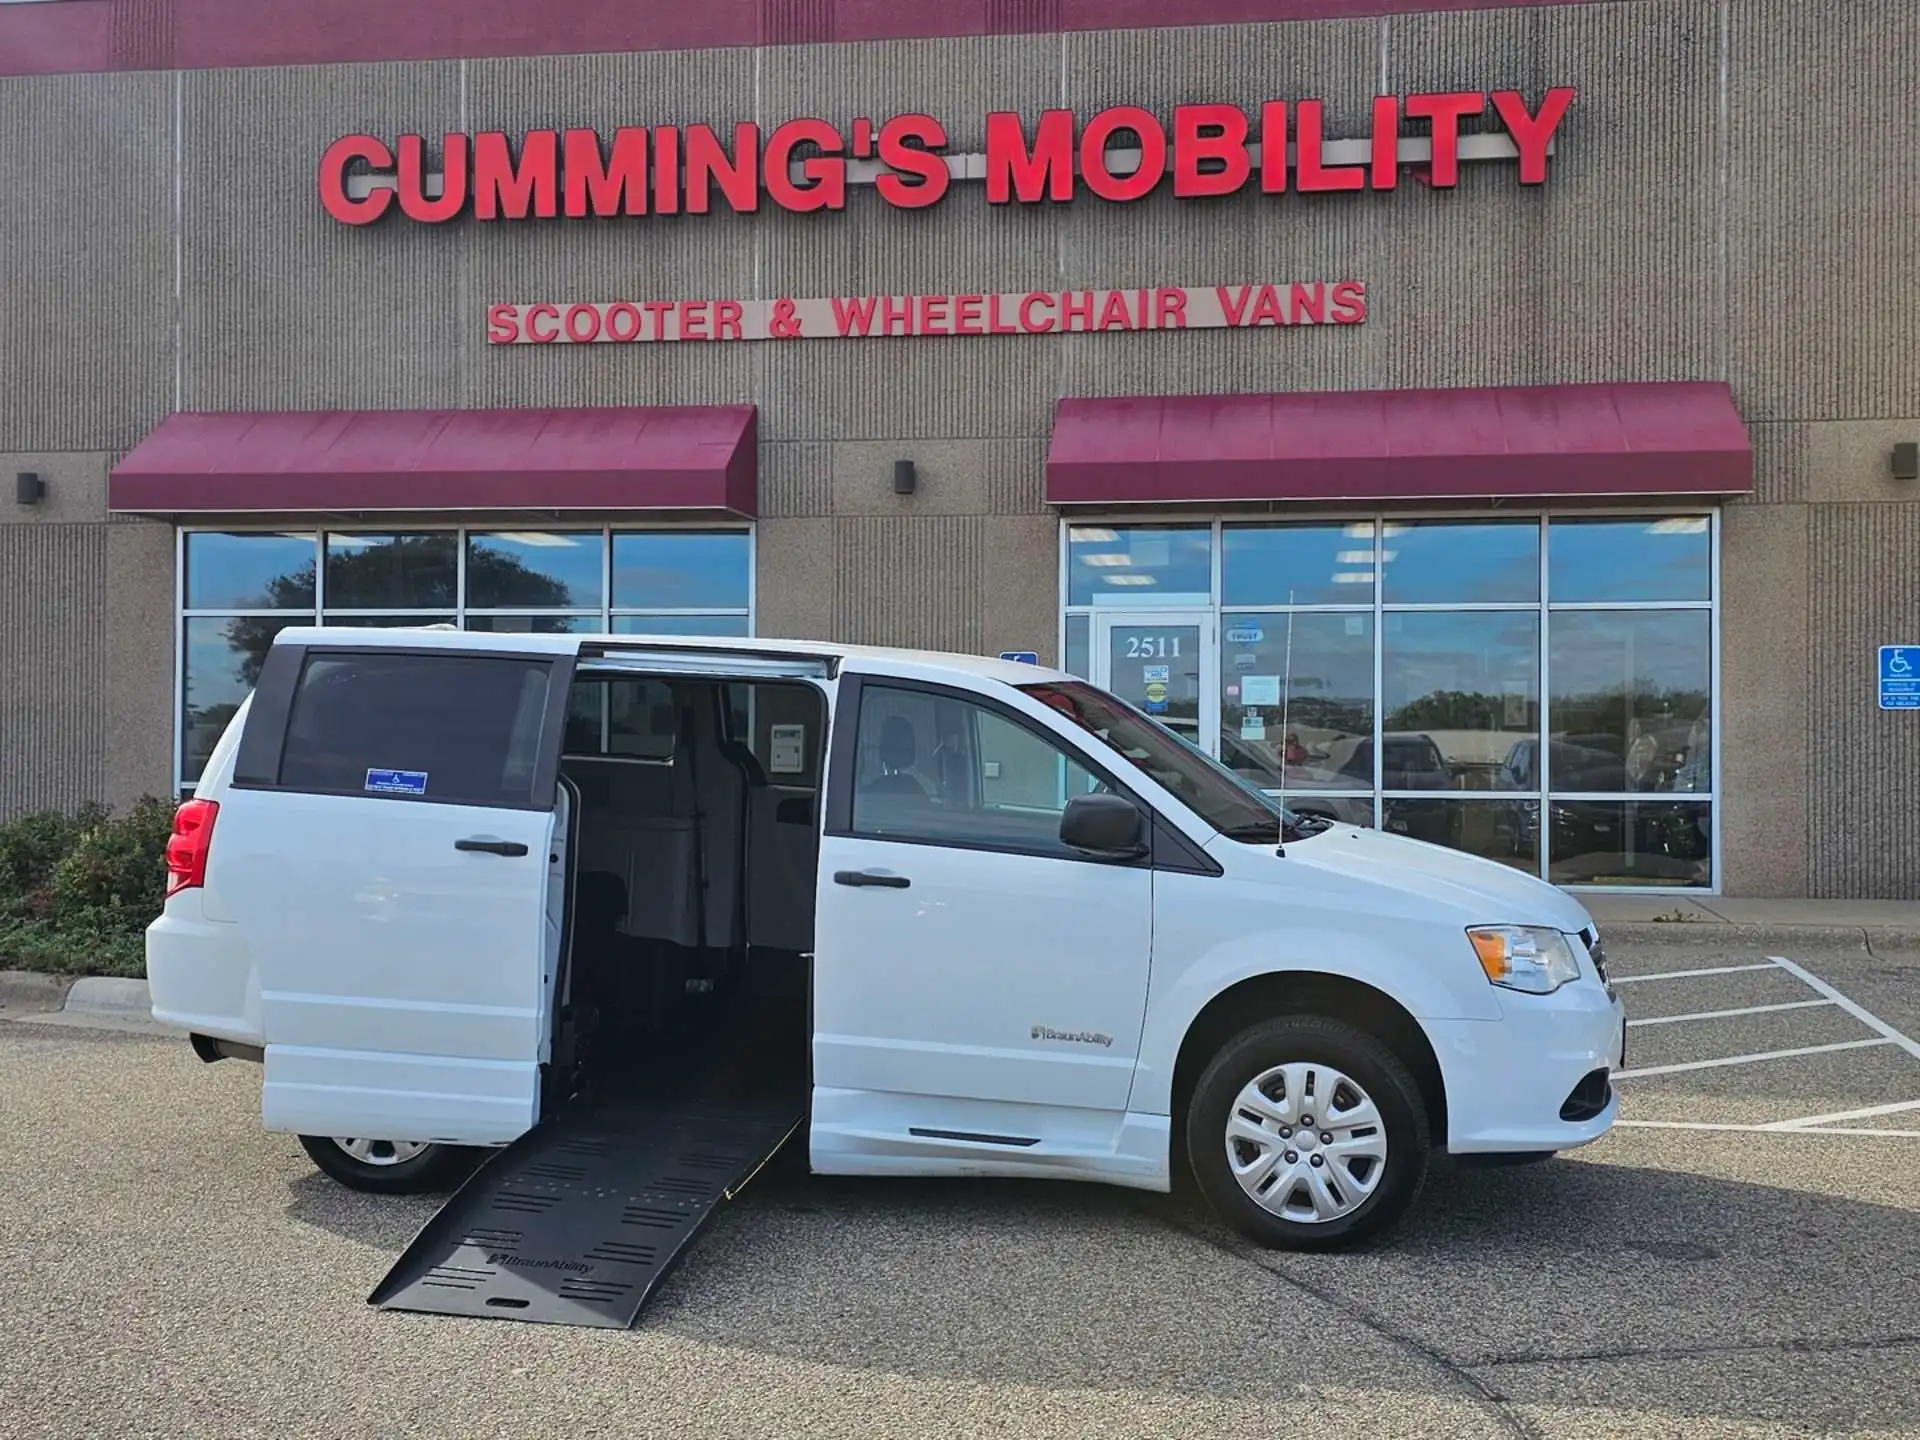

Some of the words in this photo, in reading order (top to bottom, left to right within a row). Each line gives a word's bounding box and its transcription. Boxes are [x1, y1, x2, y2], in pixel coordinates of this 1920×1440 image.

[318, 113, 949, 225] CUMMING'S
[986, 86, 1576, 205] MOBILITY
[488, 300, 743, 344] SCOOTER
[769, 298, 801, 340] &
[832, 287, 1187, 338] WHEELCHAIR
[1216, 281, 1366, 327] VANS
[1126, 637, 1181, 658] 2511
[1046, 1028, 1113, 1047] BraunAbility
[506, 1256, 594, 1274] BraunAbility
